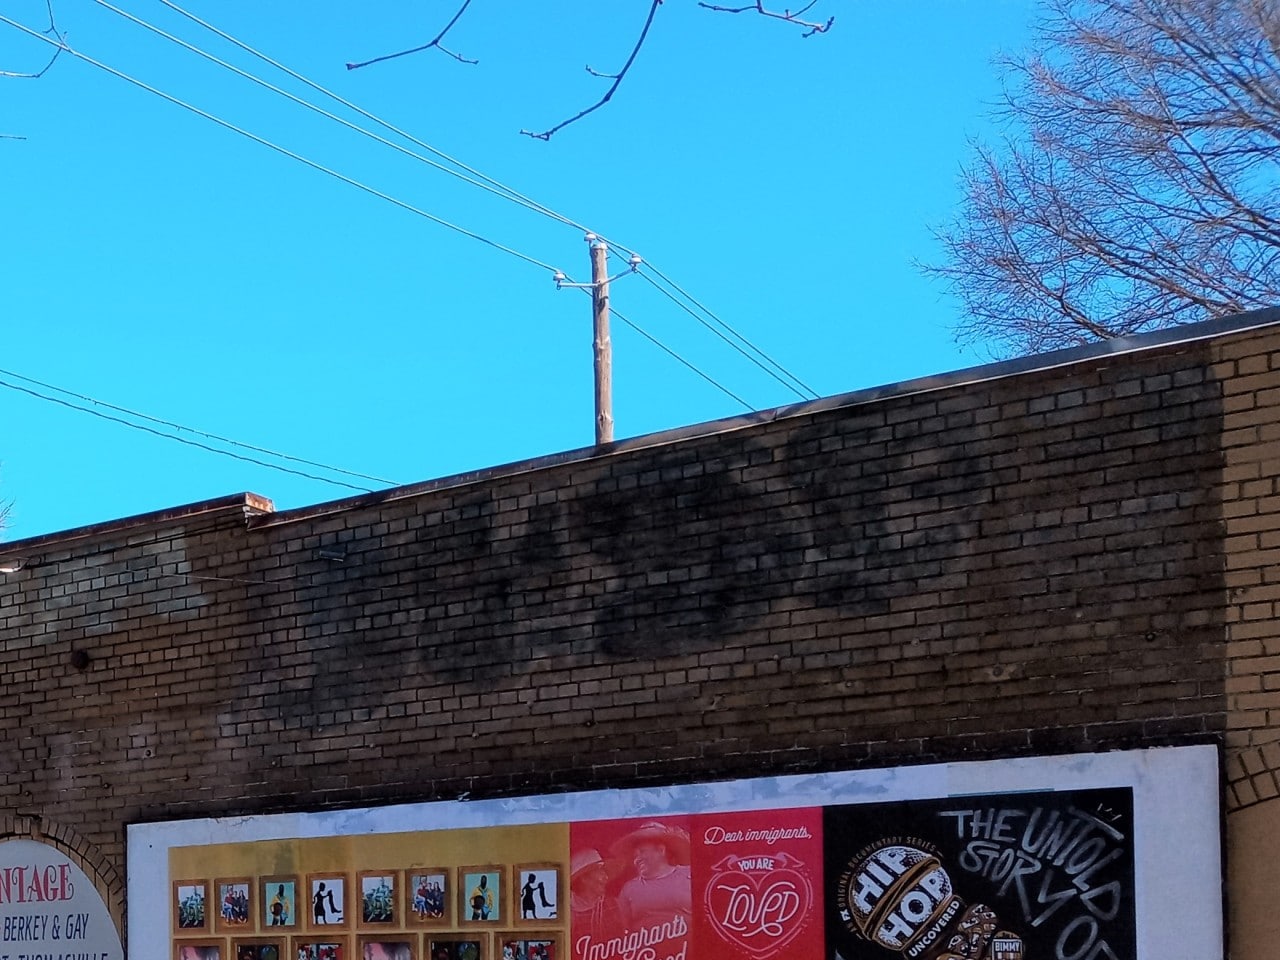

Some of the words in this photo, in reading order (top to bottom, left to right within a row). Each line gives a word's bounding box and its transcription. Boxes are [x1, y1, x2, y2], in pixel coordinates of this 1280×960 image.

[704, 827, 743, 845] Dear
[745, 826, 813, 845] immigrants,
[938, 808, 1024, 843] THE
[906, 836, 937, 851] SERIES
[738, 858, 755, 872] YOU
[756, 857, 774, 871] ARE
[1022, 806, 1125, 920] UNTOLD
[853, 848, 908, 915] HIP
[959, 841, 1078, 927] STORY
[877, 867, 948, 947] HOP
[3, 915, 48, 942] BERKEY
[51, 915, 61, 939] &
[65, 913, 89, 940] GAY
[908, 900, 960, 957] UNCOVERED
[995, 941, 1020, 952] BIMMY
